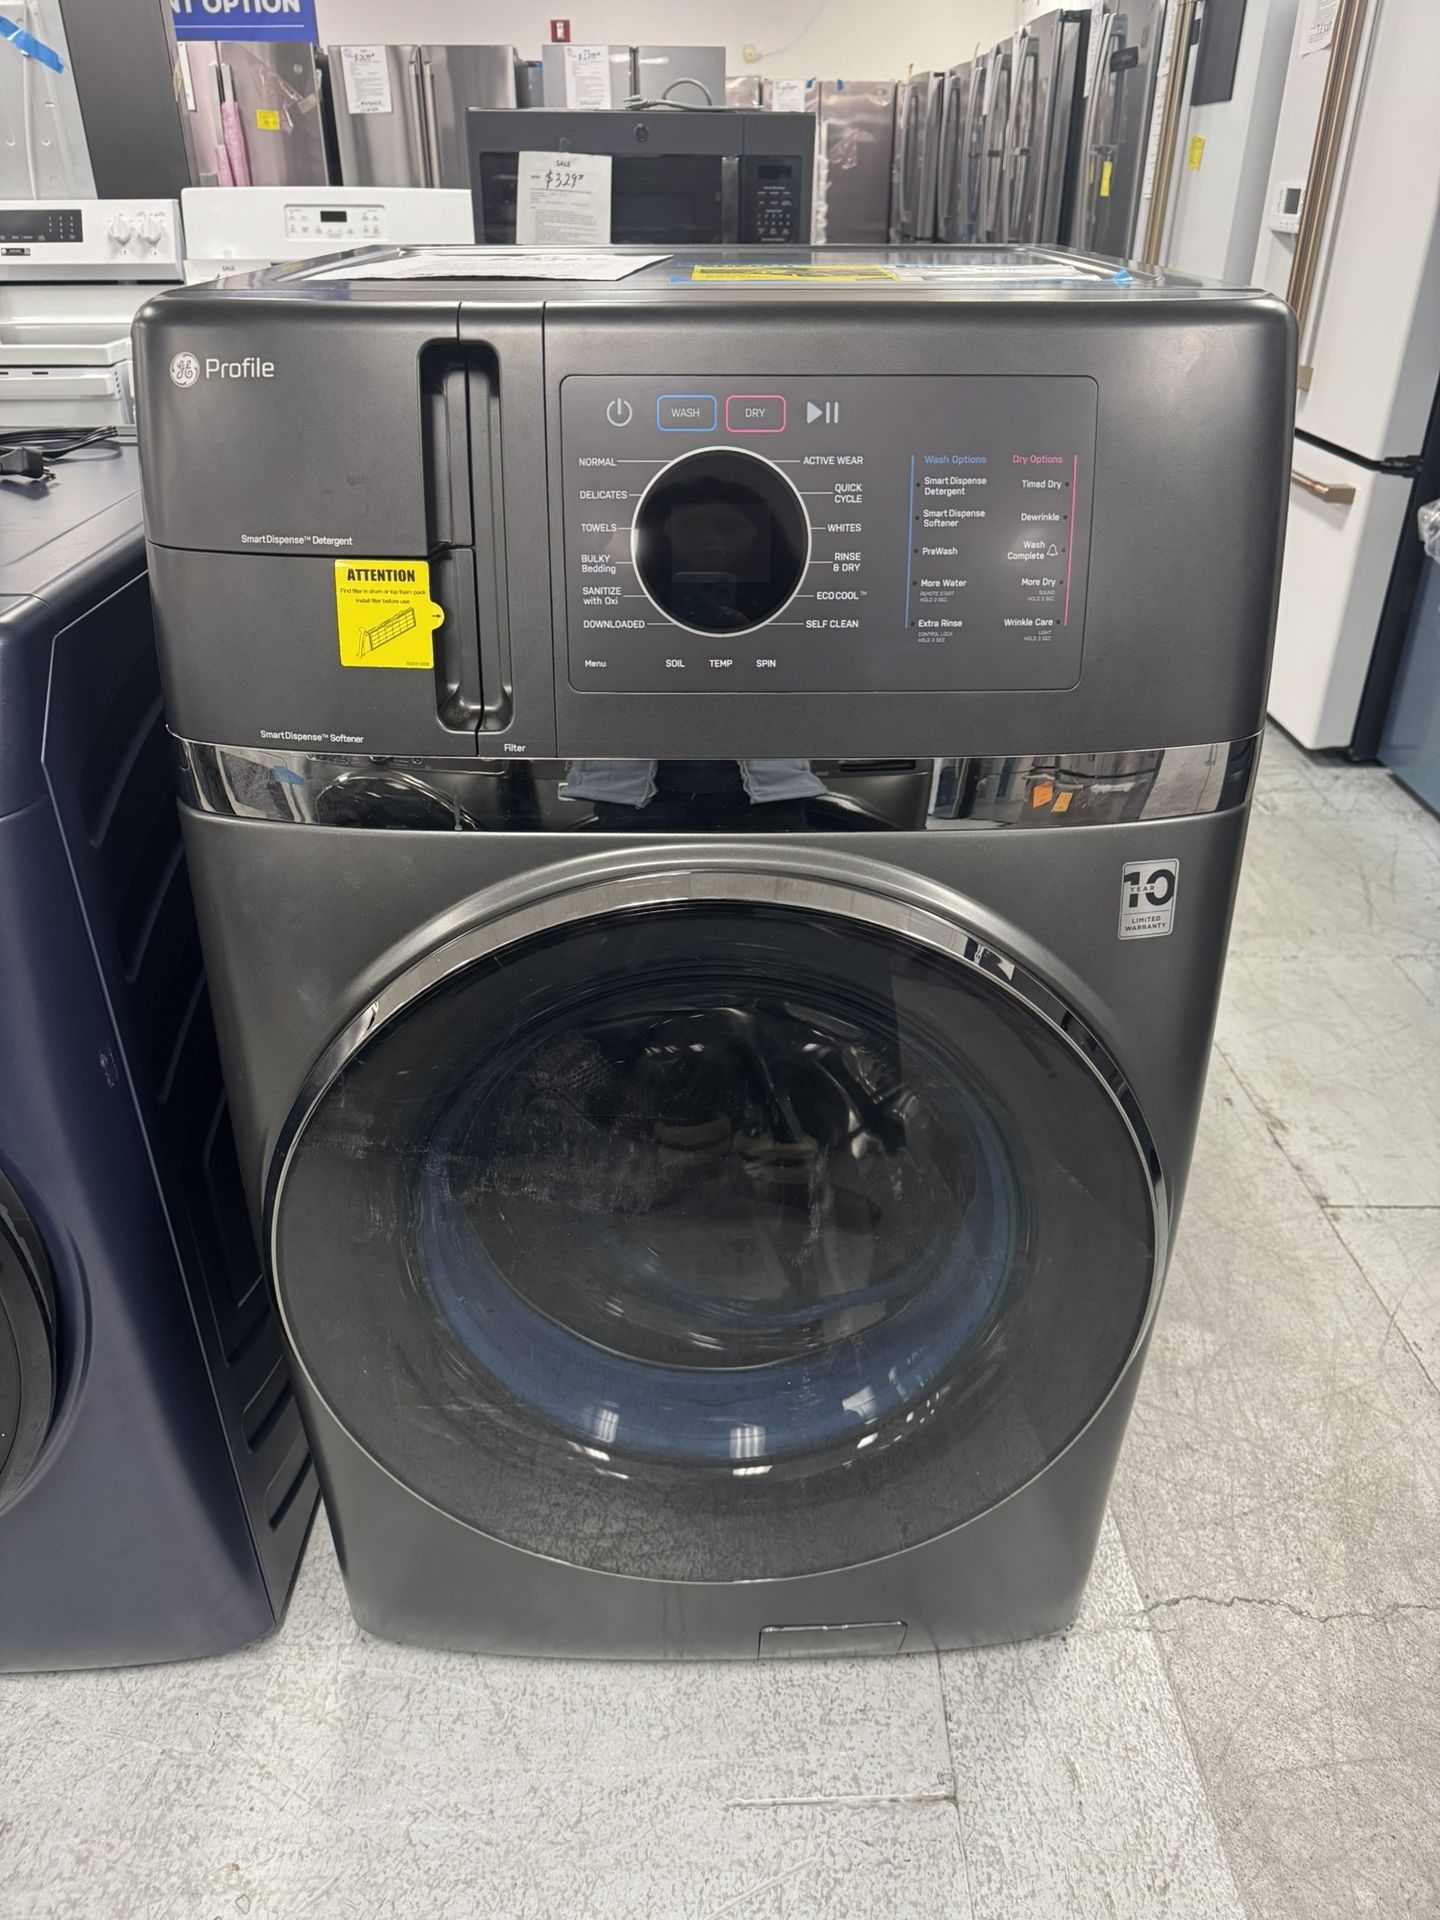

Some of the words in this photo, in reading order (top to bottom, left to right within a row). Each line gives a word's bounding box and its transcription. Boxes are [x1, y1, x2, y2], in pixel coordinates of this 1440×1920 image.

[202, 0, 301, 13] OPTION
[205, 357, 275, 379] Profile
[671, 408, 700, 418] WASH
[745, 408, 766, 418] DRY
[579, 458, 617, 467] NORMAL
[803, 456, 835, 465] ACTIVE
[836, 456, 863, 465] WEAR
[924, 455, 949, 464] Wash
[952, 455, 987, 466] Options
[1013, 455, 1028, 465] Dry
[1030, 455, 1063, 466] Options
[924, 477, 949, 485] Smart
[950, 477, 987, 487] Dispense
[1021, 480, 1046, 488] Timed
[1047, 480, 1062, 490] Dry
[834, 484, 863, 493] QUICK
[924, 487, 966, 497] Detergent
[579, 491, 627, 500] DELICATES
[834, 494, 863, 503] CYCLE
[923, 509, 947, 518] Smart
[948, 509, 986, 519] Dispense
[1020, 513, 1060, 521] Dewrinkle
[581, 523, 617, 532] TOWELS
[827, 523, 862, 533] WHITES
[923, 519, 959, 528] Softener
[312, 535, 353, 547] Detergent
[1023, 541, 1046, 549] Wash
[922, 547, 958, 556] PreWash
[1007, 551, 1045, 561] Complete
[581, 554, 610, 563] BULKY
[834, 552, 861, 561] RINSE
[582, 564, 616, 575] Bedding
[833, 563, 840, 572] &
[841, 563, 860, 572] DRY
[347, 569, 415, 582] ATTENTION
[921, 579, 940, 587] More
[942, 579, 967, 587] Water
[1021, 578, 1041, 586] More
[1042, 578, 1056, 588] Dry
[582, 587, 622, 596] SANITIZE
[817, 591, 834, 600] ECO
[583, 597, 602, 606] with
[604, 597, 618, 606] Oxi
[583, 619, 645, 629] DOWNLOADED
[806, 619, 828, 628] SELF
[829, 619, 859, 628] CLEAN
[918, 619, 939, 627] Extra
[940, 619, 963, 627] Rinse
[1003, 618, 1033, 627] Wrinkle
[1035, 618, 1054, 627] Care
[585, 660, 606, 668] Menu
[665, 659, 685, 668] SOIL
[709, 659, 733, 668] TEMP
[756, 659, 776, 668] SPIN
[330, 733, 364, 743] Softener
[504, 743, 526, 752] Filter
[1124, 869, 1176, 908] 10
[1130, 885, 1155, 893] YEAR
[1131, 915, 1161, 924] LIMITED
[1124, 922, 1167, 932] WARRANTY
